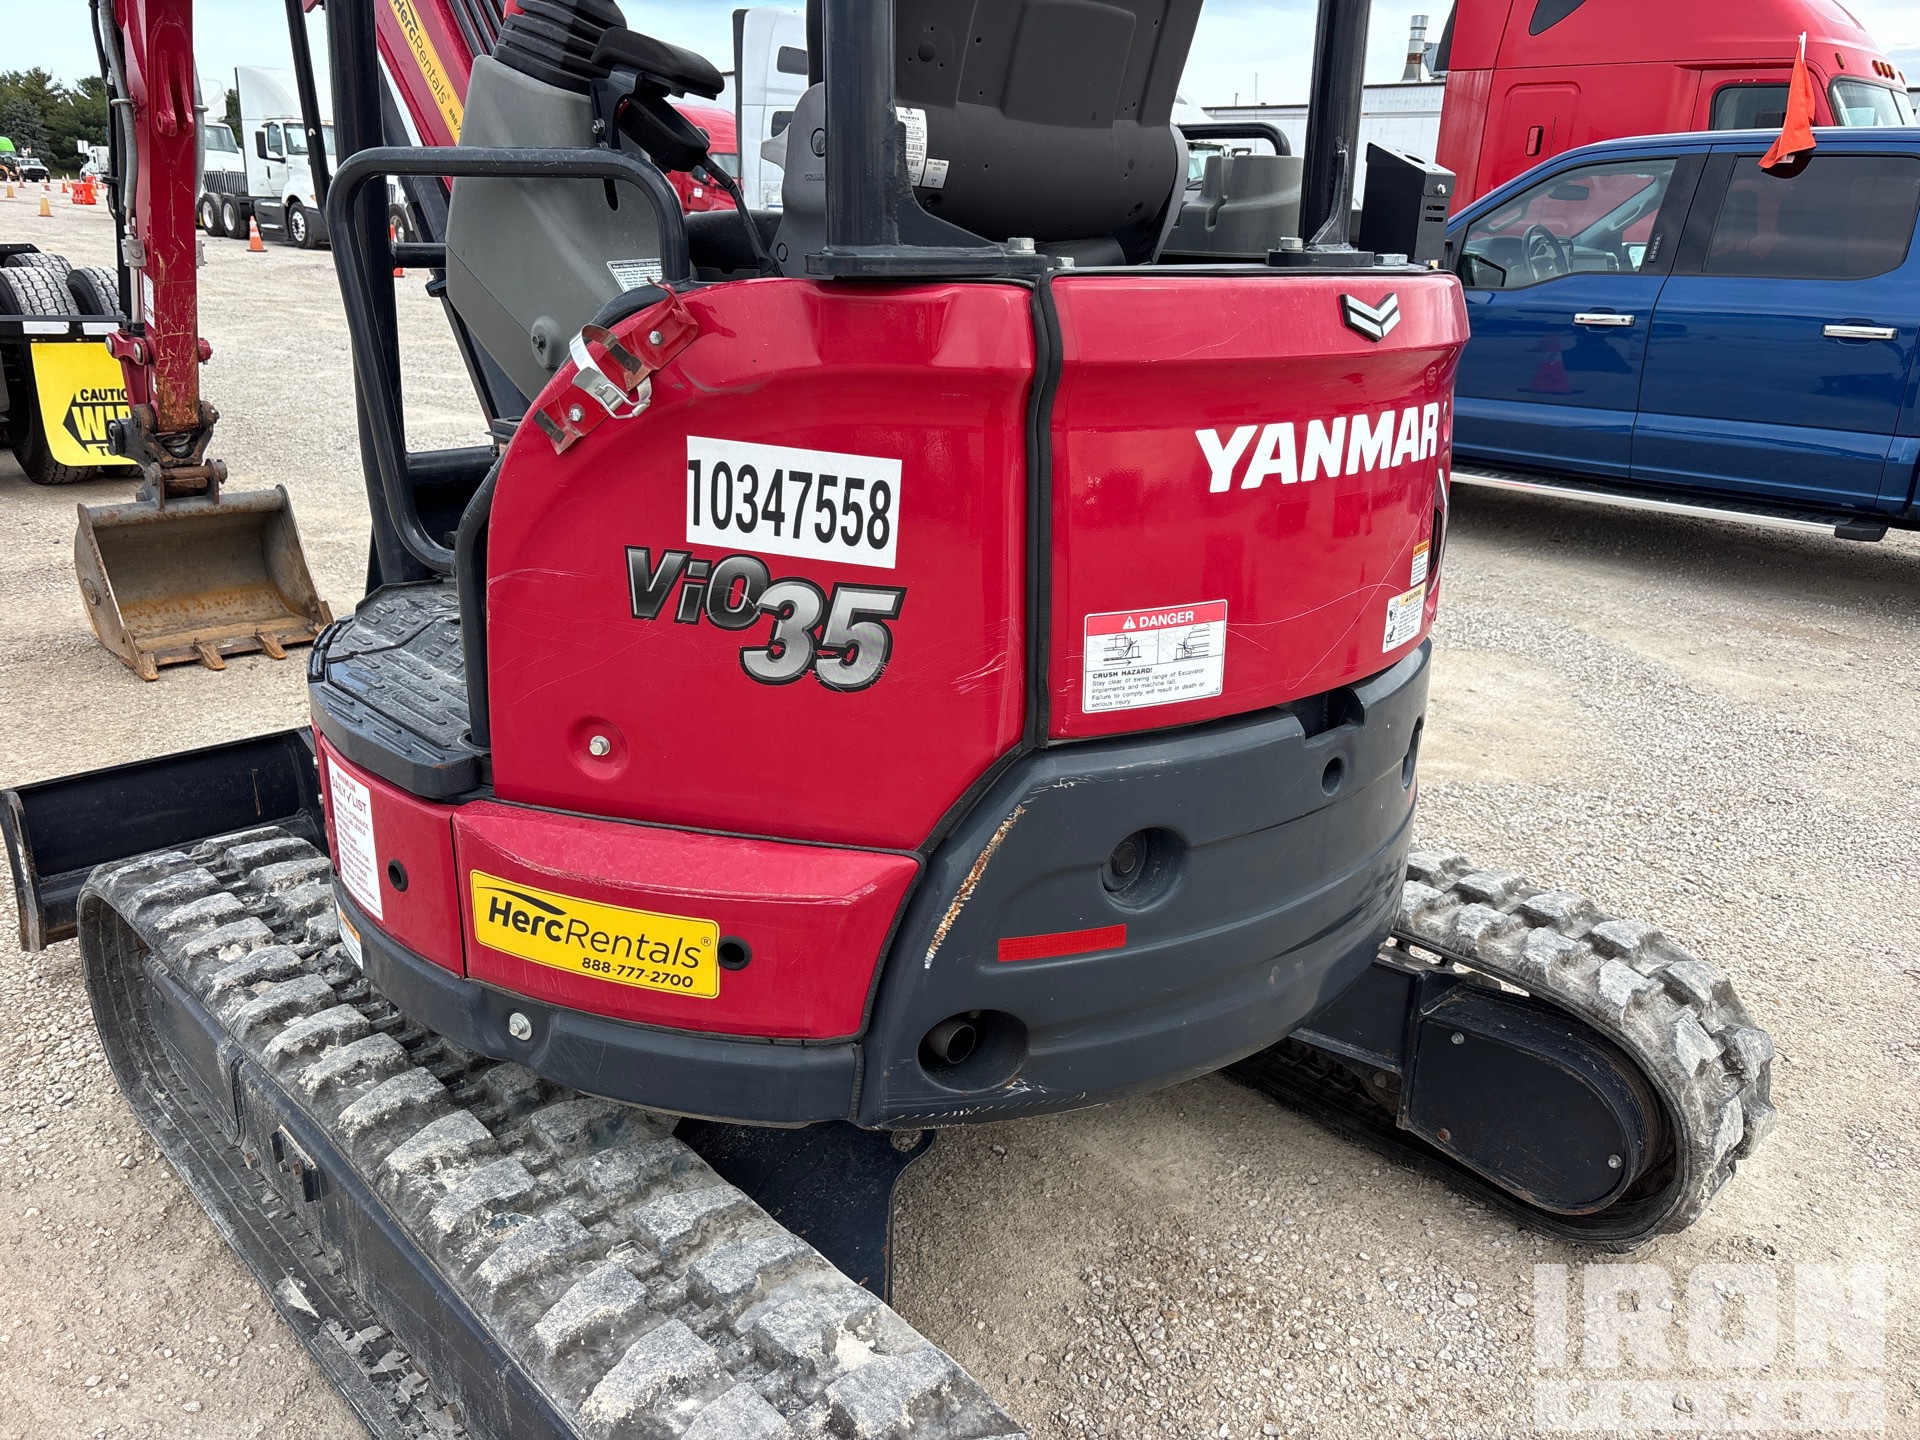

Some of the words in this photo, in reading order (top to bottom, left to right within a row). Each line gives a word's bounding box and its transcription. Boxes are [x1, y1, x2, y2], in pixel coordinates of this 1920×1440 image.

[80, 388, 129, 402] CAUTIO
[1195, 402, 1439, 493] YANMAR
[687, 459, 892, 550] 10347558
[1139, 610, 1195, 628] DANGER
[1121, 667, 1153, 677] HAZARD!
[1133, 675, 1150, 683] swing
[1178, 668, 1205, 677] Excavator
[1092, 693, 1111, 701] Failure
[1122, 690, 1143, 698] comply
[1181, 682, 1197, 690] death
[1141, 681, 1165, 689] machine
[331, 775, 346, 798] DAILY
[352, 794, 367, 815] LIST
[581, 957, 694, 988] 888-777-2700
